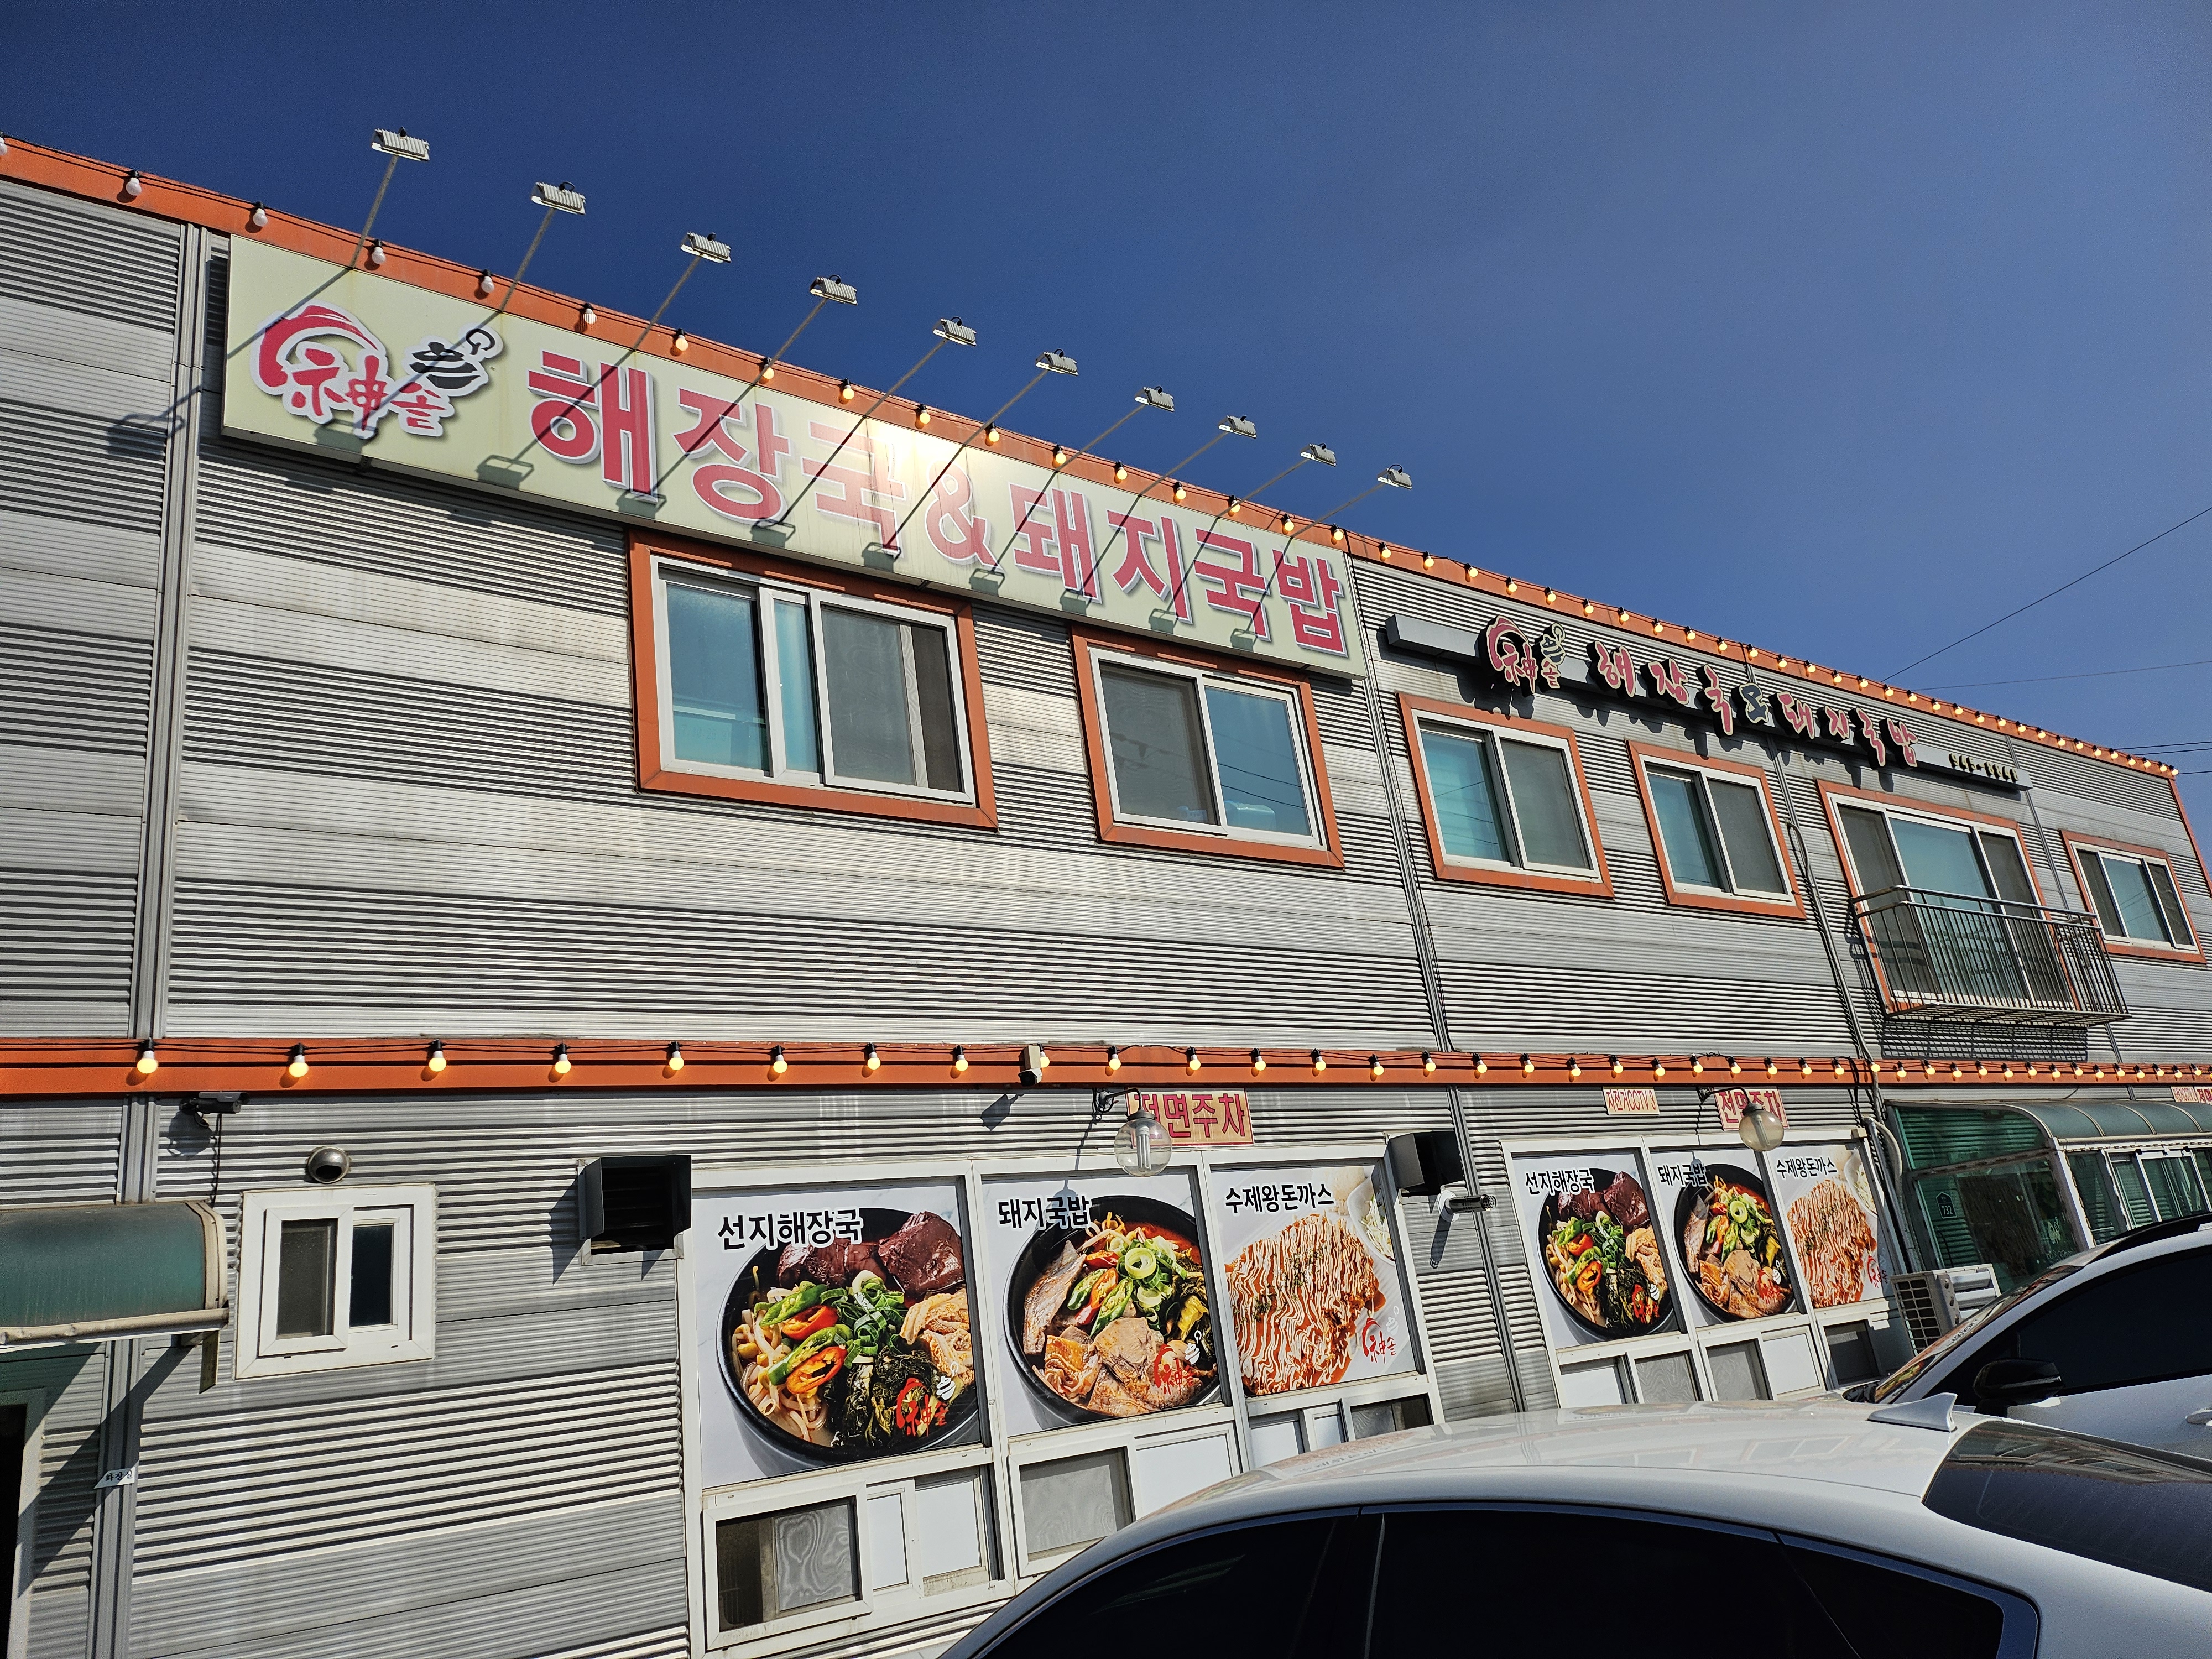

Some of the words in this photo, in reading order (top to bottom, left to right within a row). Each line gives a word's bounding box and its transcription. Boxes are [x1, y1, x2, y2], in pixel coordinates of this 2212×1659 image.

[527, 350, 1348, 658] 해장국&돼지국밥
[1658, 1163, 1706, 1186] 돼지국밥
[1777, 1157, 1837, 1177] 수제왕돈까스
[1526, 1169, 1594, 1193] 선지해장국
[1225, 1183, 1334, 1213] 수제왕돈까스
[1942, 1206, 1953, 1214] 732
[999, 1195, 1091, 1229] 돼지국밥
[718, 1209, 862, 1249] 선지해장국
